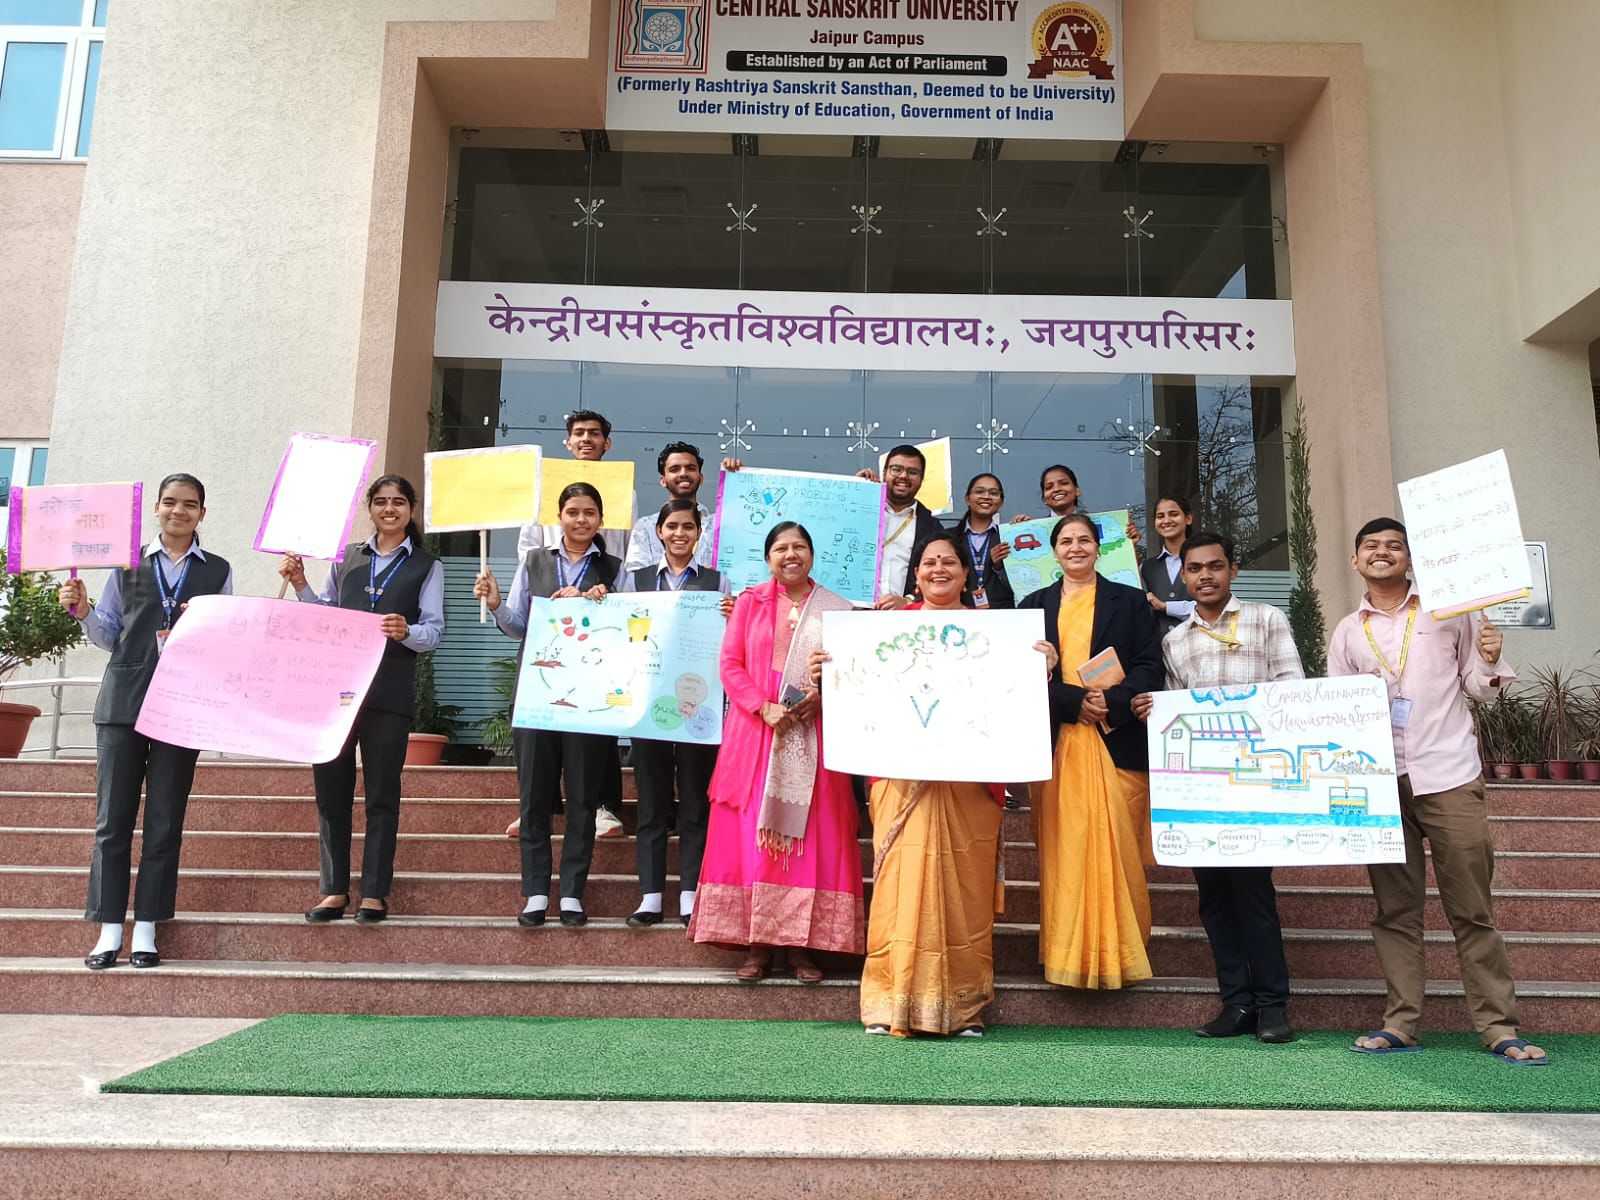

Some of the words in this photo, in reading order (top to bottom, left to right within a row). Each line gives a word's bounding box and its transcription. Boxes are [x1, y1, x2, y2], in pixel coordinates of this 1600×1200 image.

[716, 0, 801, 17] CENTRAL
[807, 0, 900, 19] SANSKRIT
[906, 0, 1018, 22] UNIVERSITY
[810, 30, 858, 46] Jaipur
[863, 30, 925, 48] Campus
[1050, 23, 1092, 51] A++
[746, 54, 825, 68] Established
[829, 55, 844, 71] by
[848, 58, 865, 69] an
[868, 56, 892, 69] Act
[896, 57, 910, 70] of
[913, 57, 988, 71] Parliament
[1053, 58, 1089, 68] NAAC
[617, 76, 690, 94] (Formerly
[695, 78, 768, 96] Rashtriya
[772, 79, 836, 95] Sanskrit
[841, 81, 918, 98] Sansthan,
[923, 82, 984, 97] Deemed
[989, 84, 1005, 98] to
[1010, 85, 1028, 99] be
[1033, 85, 1115, 103] University)
[678, 99, 723, 114] Under
[727, 100, 789, 118] Ministry
[794, 102, 809, 116] of
[814, 102, 896, 119] Education,
[901, 103, 990, 119] Government
[996, 105, 1011, 120] of
[1016, 106, 1054, 121] India
[1020, 310, 1256, 359] जयपुरपरिसरः
